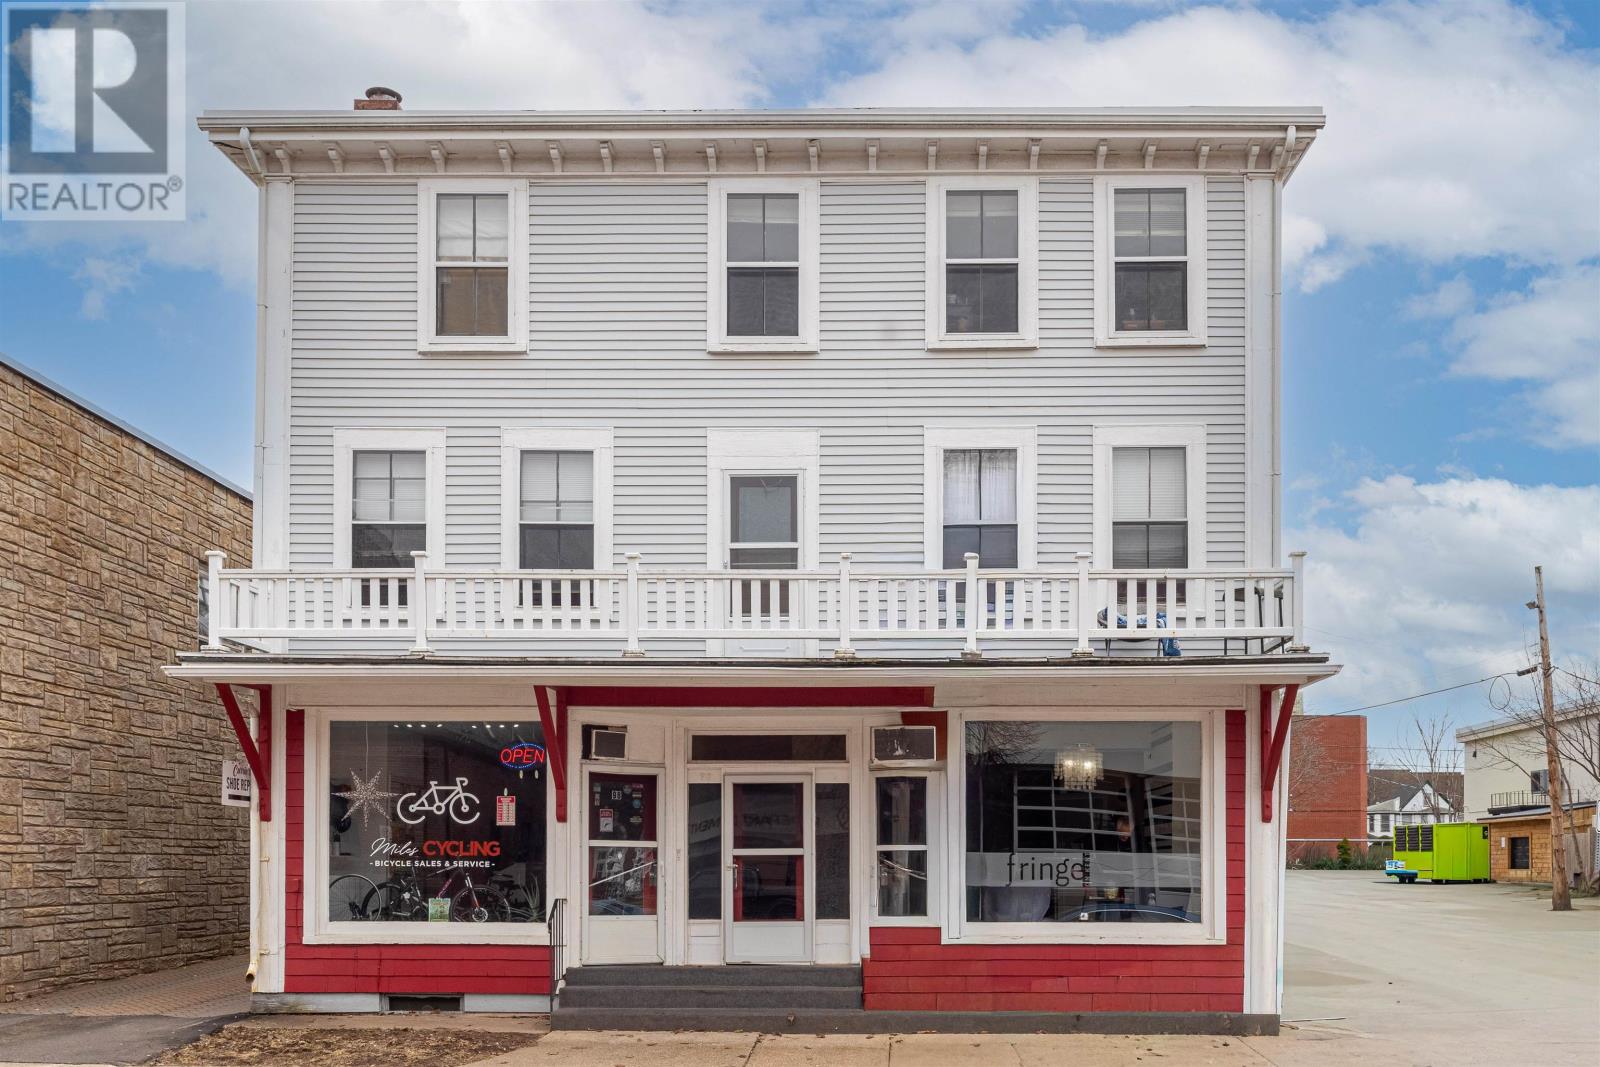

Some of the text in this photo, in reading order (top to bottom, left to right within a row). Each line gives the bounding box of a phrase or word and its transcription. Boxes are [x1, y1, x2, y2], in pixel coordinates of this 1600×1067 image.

[500, 748, 545, 763] OPEN
[226, 777, 240, 791] SHOE
[370, 838, 501, 857] Miles CYCLING
[1006, 853, 1086, 887] fringe
